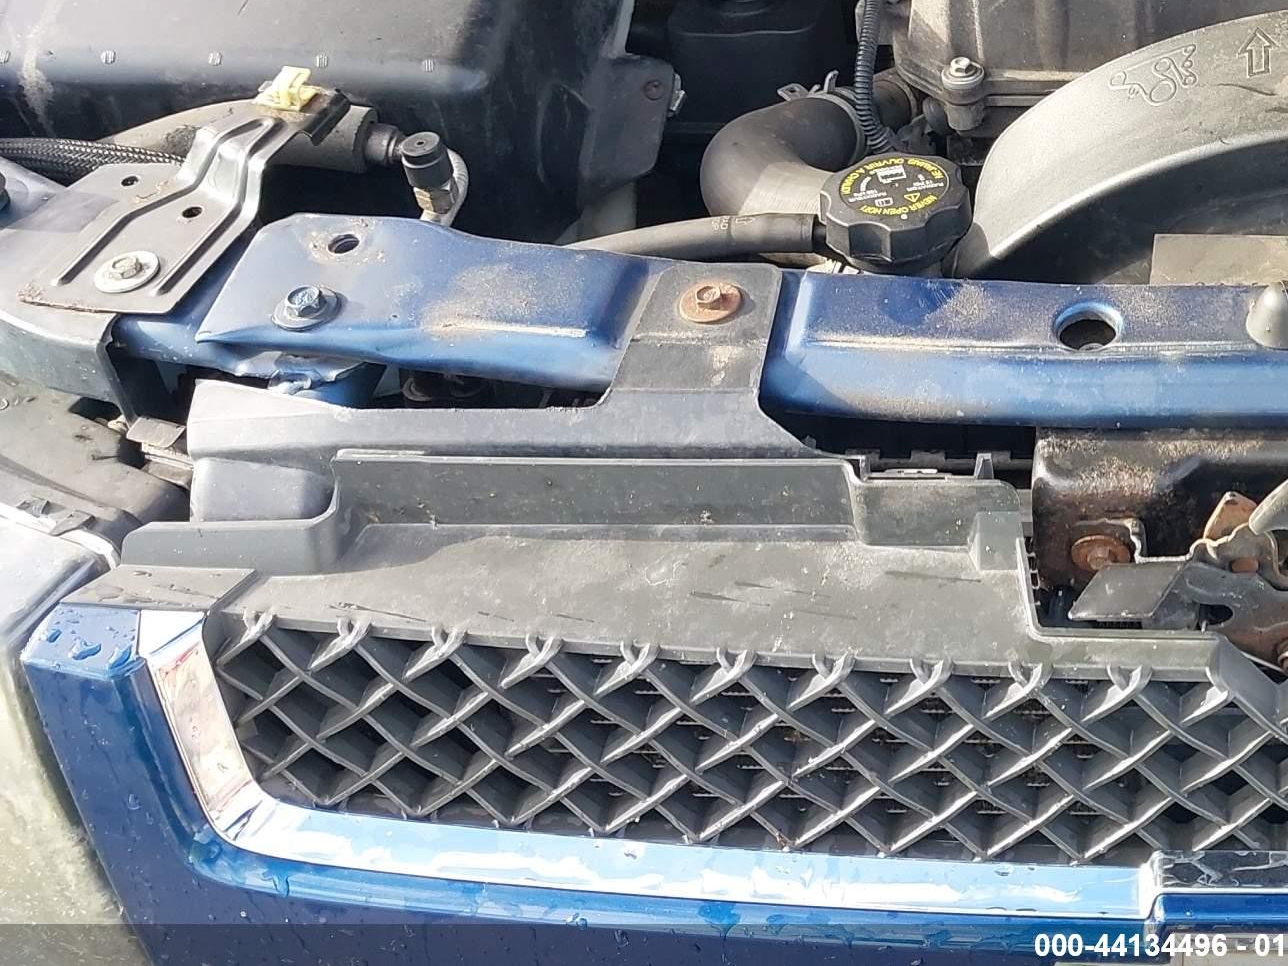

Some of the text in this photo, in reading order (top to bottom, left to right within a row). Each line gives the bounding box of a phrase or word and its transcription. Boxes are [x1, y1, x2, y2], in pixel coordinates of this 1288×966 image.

[863, 158, 905, 171] OUVRIR
[907, 157, 938, 172] JAMAIS
[841, 172, 860, 195] CHAUD
[909, 194, 938, 211] NEVER
[882, 206, 909, 215] OPEN
